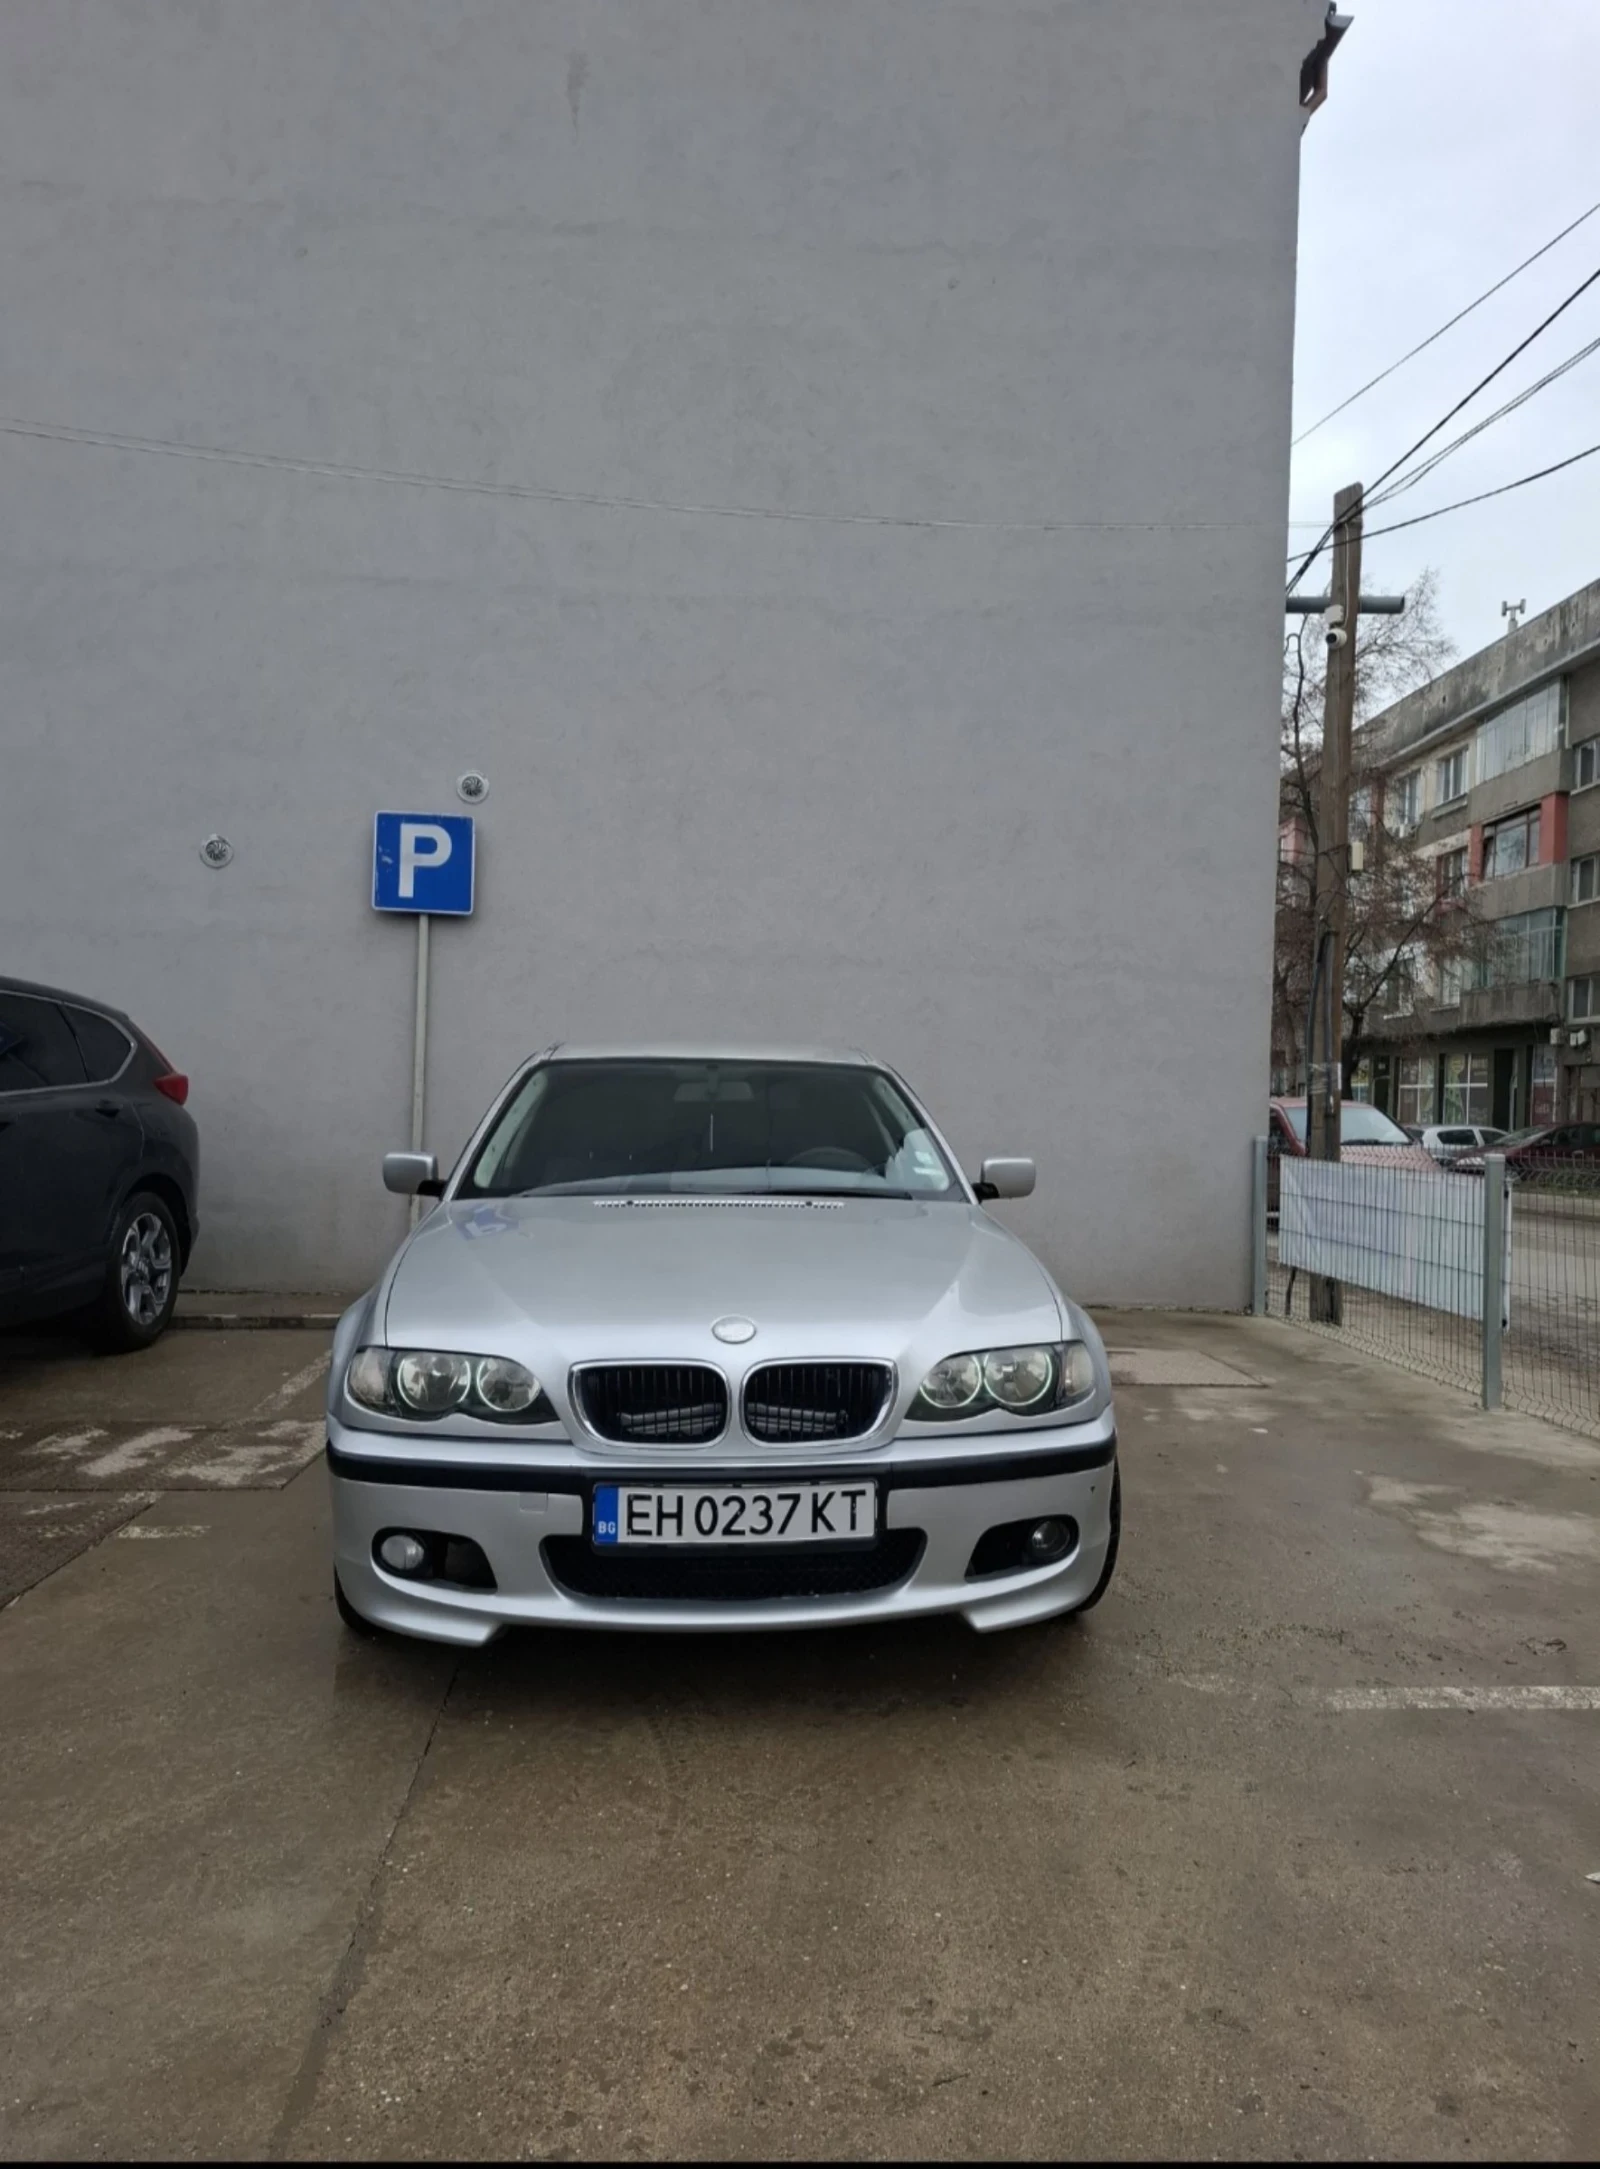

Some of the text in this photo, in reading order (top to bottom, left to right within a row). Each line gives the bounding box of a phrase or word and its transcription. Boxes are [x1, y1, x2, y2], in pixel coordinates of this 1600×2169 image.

[398, 823, 451, 898] P
[598, 1521, 616, 1534] BG
[694, 1493, 801, 1536] 0237
